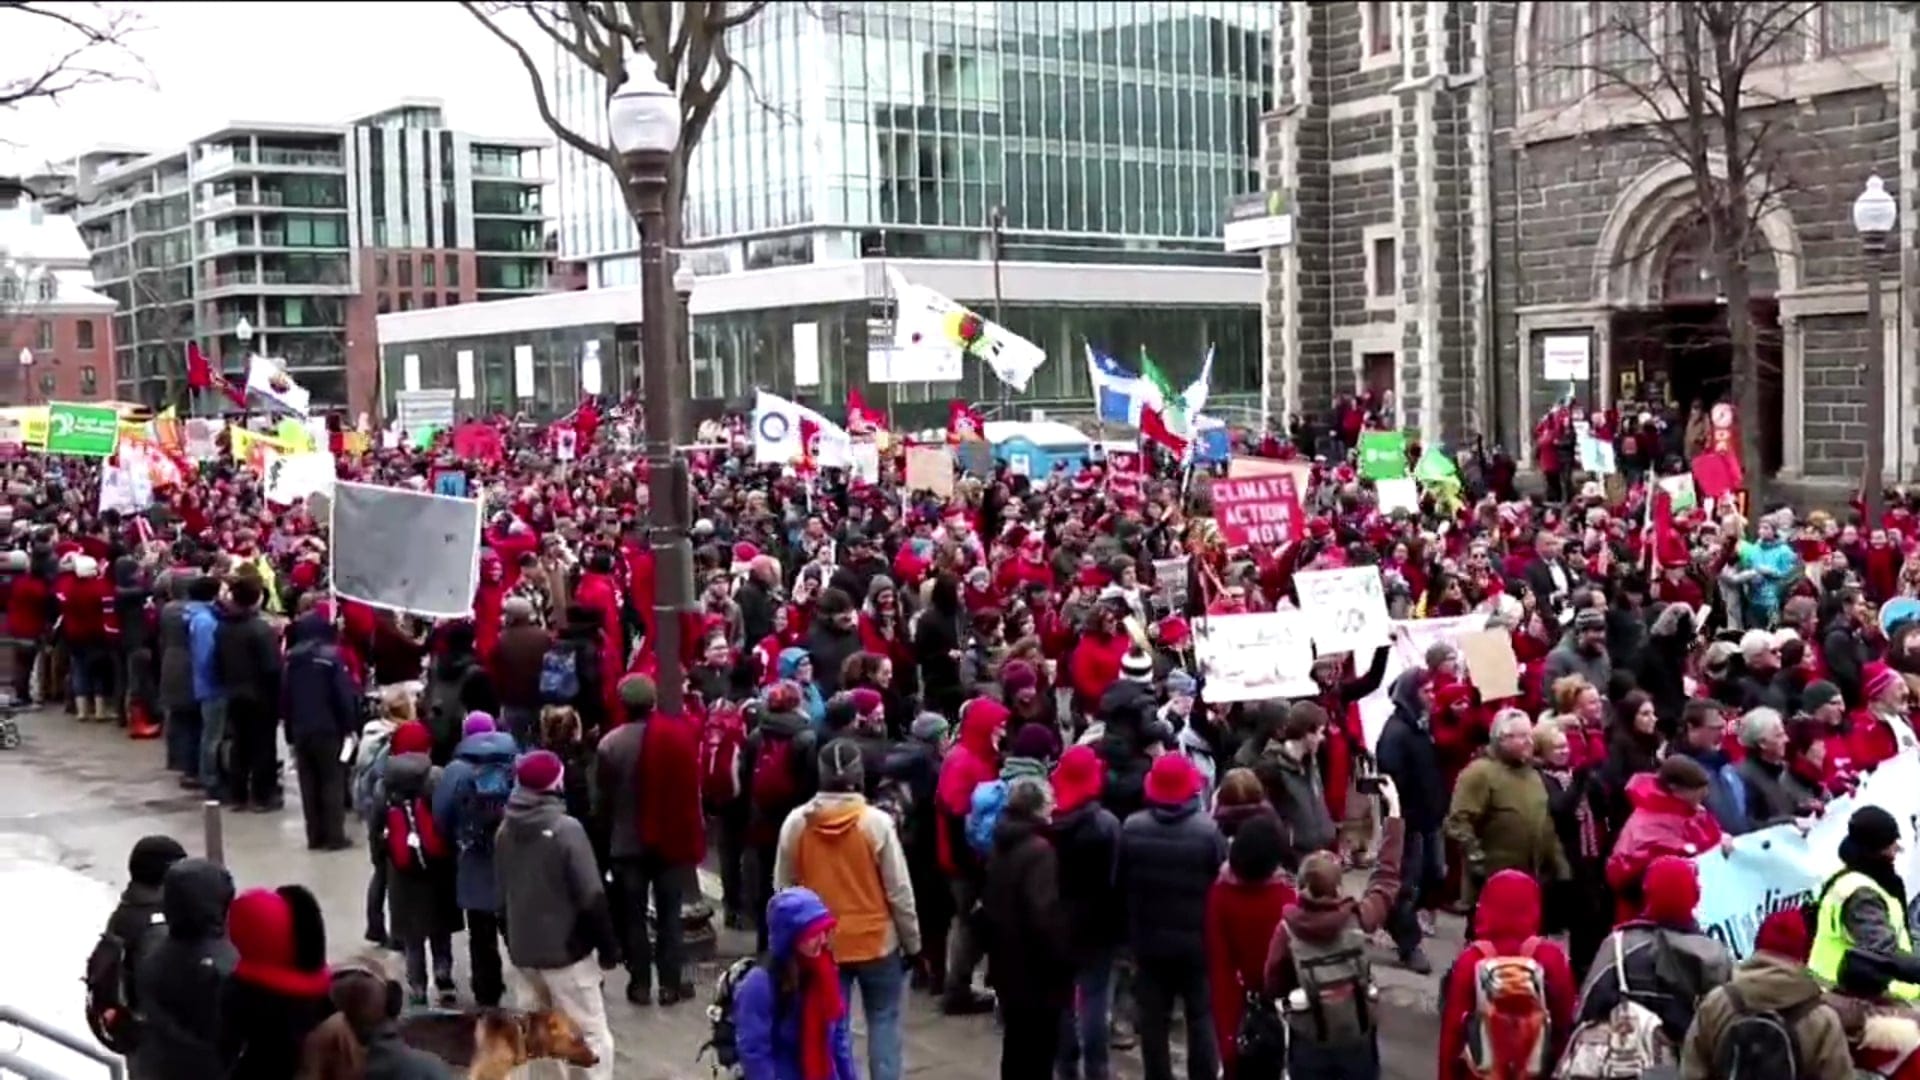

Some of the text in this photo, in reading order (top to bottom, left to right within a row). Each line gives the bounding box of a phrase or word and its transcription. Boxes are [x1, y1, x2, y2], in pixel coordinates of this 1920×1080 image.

[1212, 478, 1293, 502] CLIMATE
[1225, 502, 1290, 525] ACTION
[1247, 521, 1288, 544] NOW
